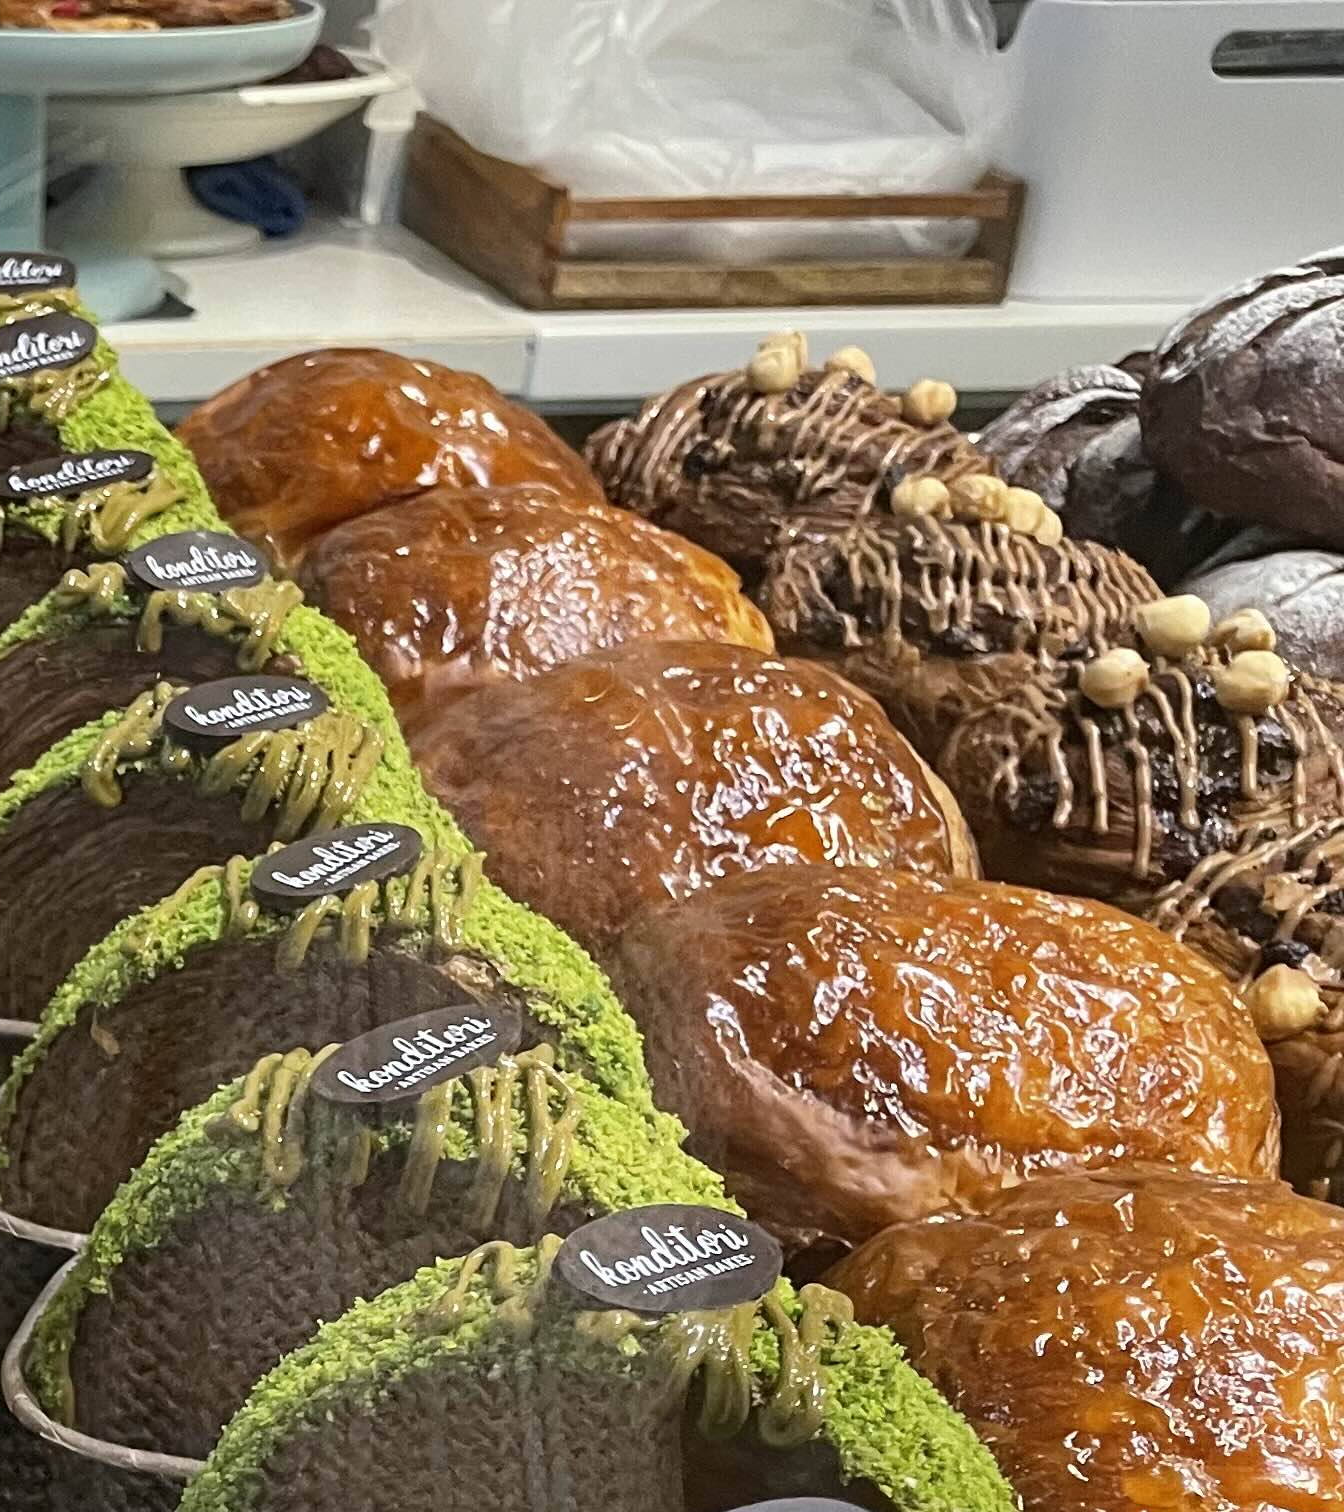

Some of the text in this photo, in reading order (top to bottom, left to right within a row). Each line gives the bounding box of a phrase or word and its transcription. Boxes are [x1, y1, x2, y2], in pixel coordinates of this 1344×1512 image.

[8, 455, 136, 492] konditori
[145, 545, 257, 580] konditori
[184, 686, 311, 728] konditori
[272, 829, 394, 890] konditori
[337, 1016, 491, 1094] konditori
[398, 1032, 496, 1091] ARTISAN BAKES
[580, 1224, 750, 1288] konditori
[646, 1254, 755, 1297] ARTISAN BAKES
